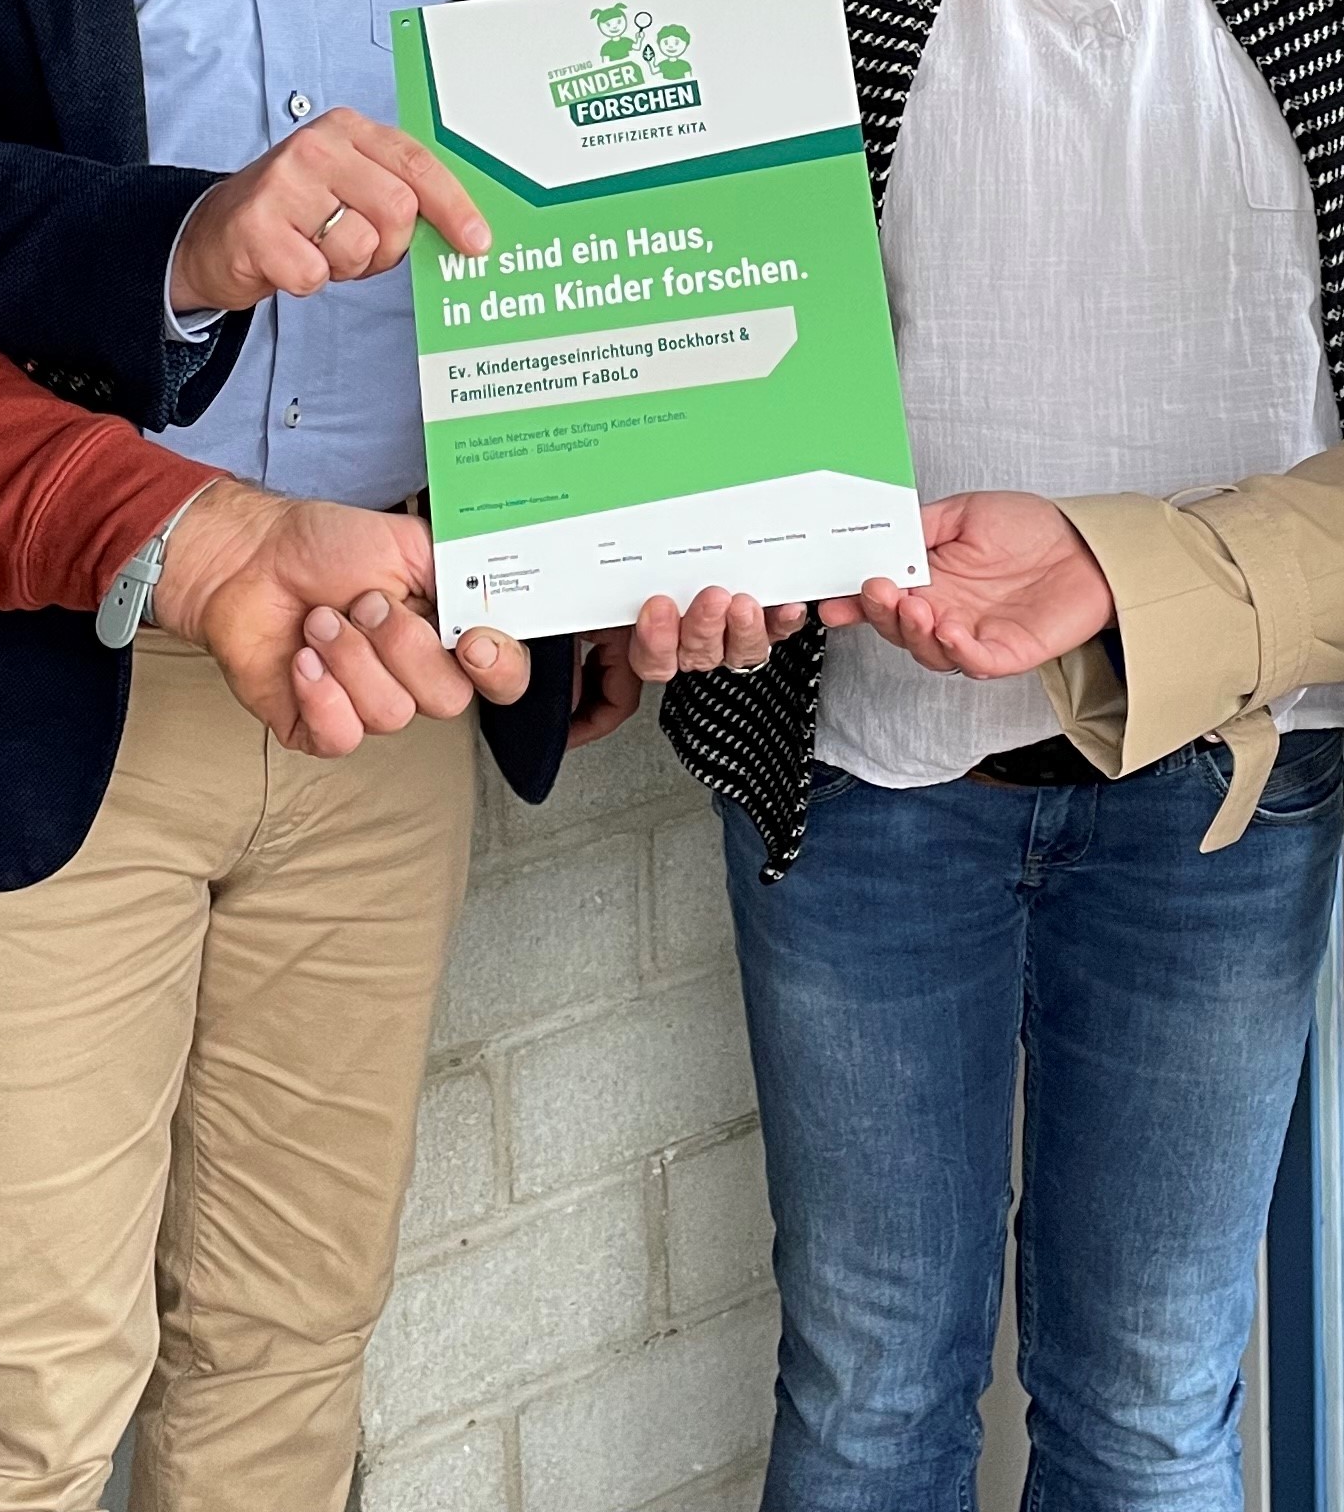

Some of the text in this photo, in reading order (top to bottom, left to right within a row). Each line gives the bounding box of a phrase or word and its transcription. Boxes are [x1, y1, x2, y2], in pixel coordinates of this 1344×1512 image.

[547, 60, 594, 80] STIFTUNG
[556, 64, 639, 103] KINDER
[575, 83, 695, 124] FORSCHEN
[581, 121, 707, 148] ZERTIFIZIERTE KITA
[437, 225, 714, 283] Wir sind ein Haus,
[441, 256, 809, 327] in dem Kinder forschen.
[447, 326, 751, 380] Ev. Kindertageseinrichtung Bockhorst &
[450, 365, 639, 404] Familienzentrum FaBoLo
[455, 437, 600, 466] Kreis Gütersloh Bildungsbüro
[469, 433, 504, 448] lokalen
[505, 428, 551, 444] Netzwerk
[552, 426, 569, 438] der
[570, 420, 609, 435] Stiftung
[610, 416, 642, 430] Kinder
